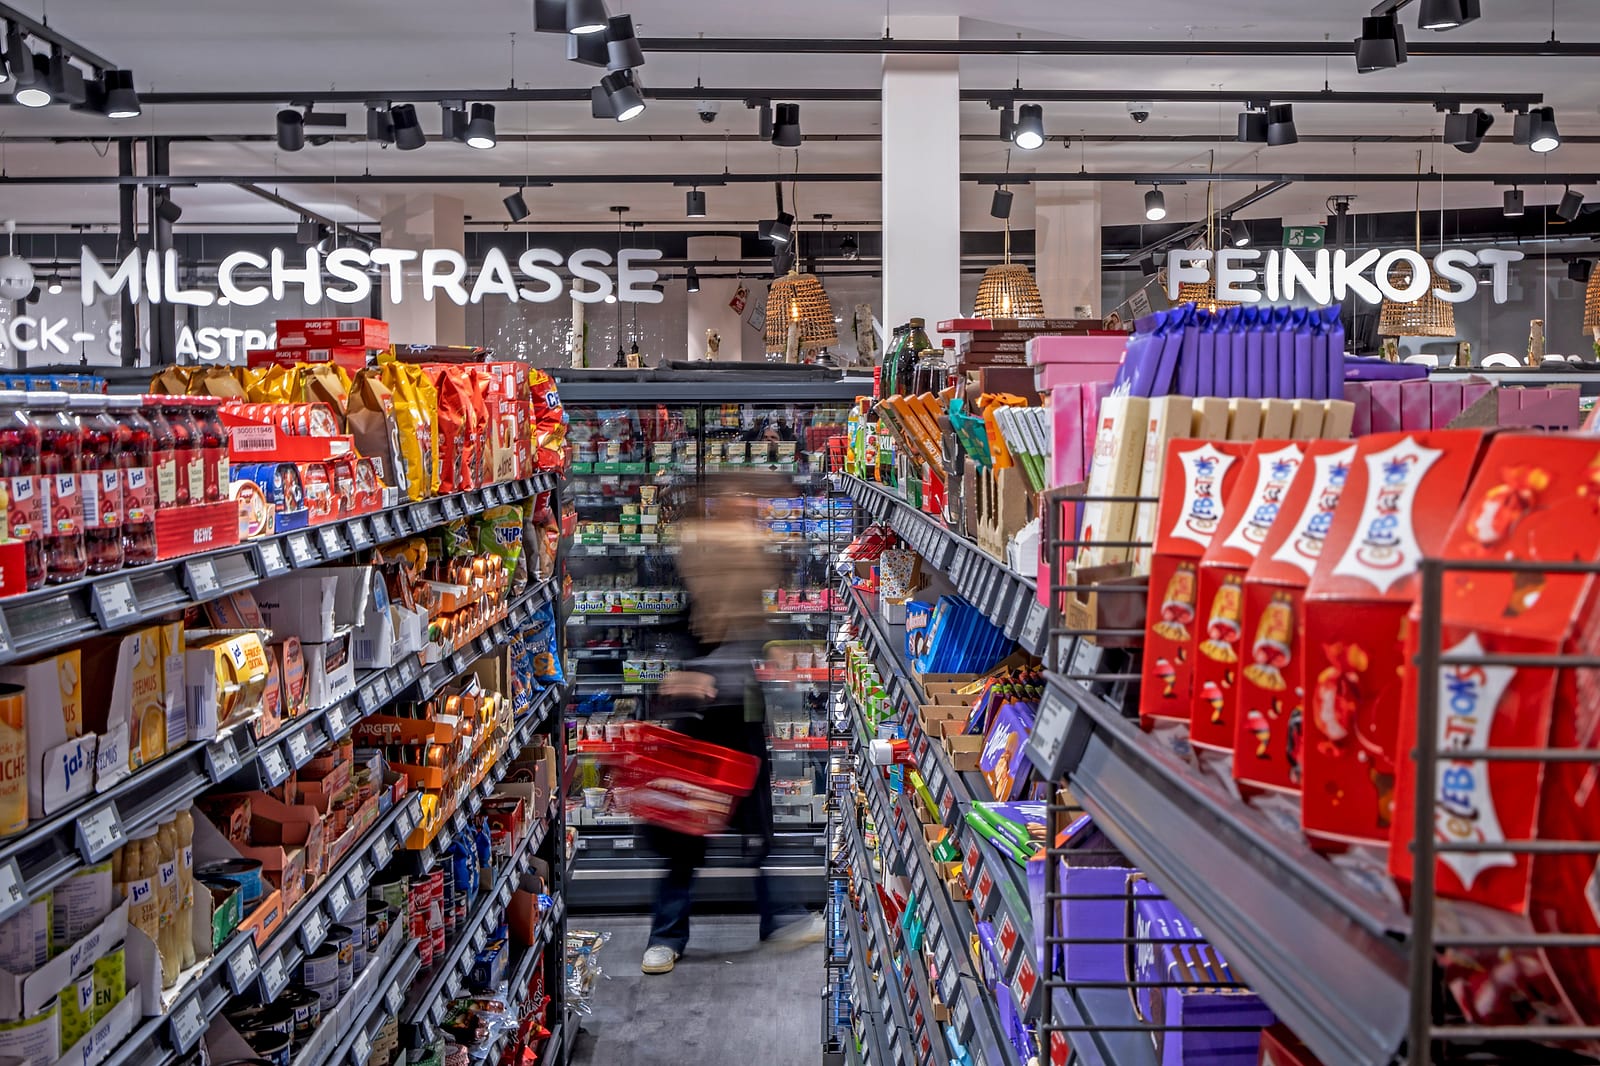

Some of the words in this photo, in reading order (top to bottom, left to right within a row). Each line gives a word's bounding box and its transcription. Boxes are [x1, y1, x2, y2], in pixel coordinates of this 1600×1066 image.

[81, 244, 664, 306] MILCHSTRASSE
[1168, 247, 1525, 305] FEINKOST
[60, 476, 73, 494] ja!
[106, 472, 116, 489] ja!
[131, 471, 143, 486] ja!
[16, 480, 31, 497] ja!
[193, 526, 213, 545] REWE
[636, 601, 679, 613] Almighurt
[358, 722, 402, 736] ARGETA
[62, 743, 84, 793] ja!
[163, 864, 174, 883] ja!
[132, 881, 149, 902] ja!
